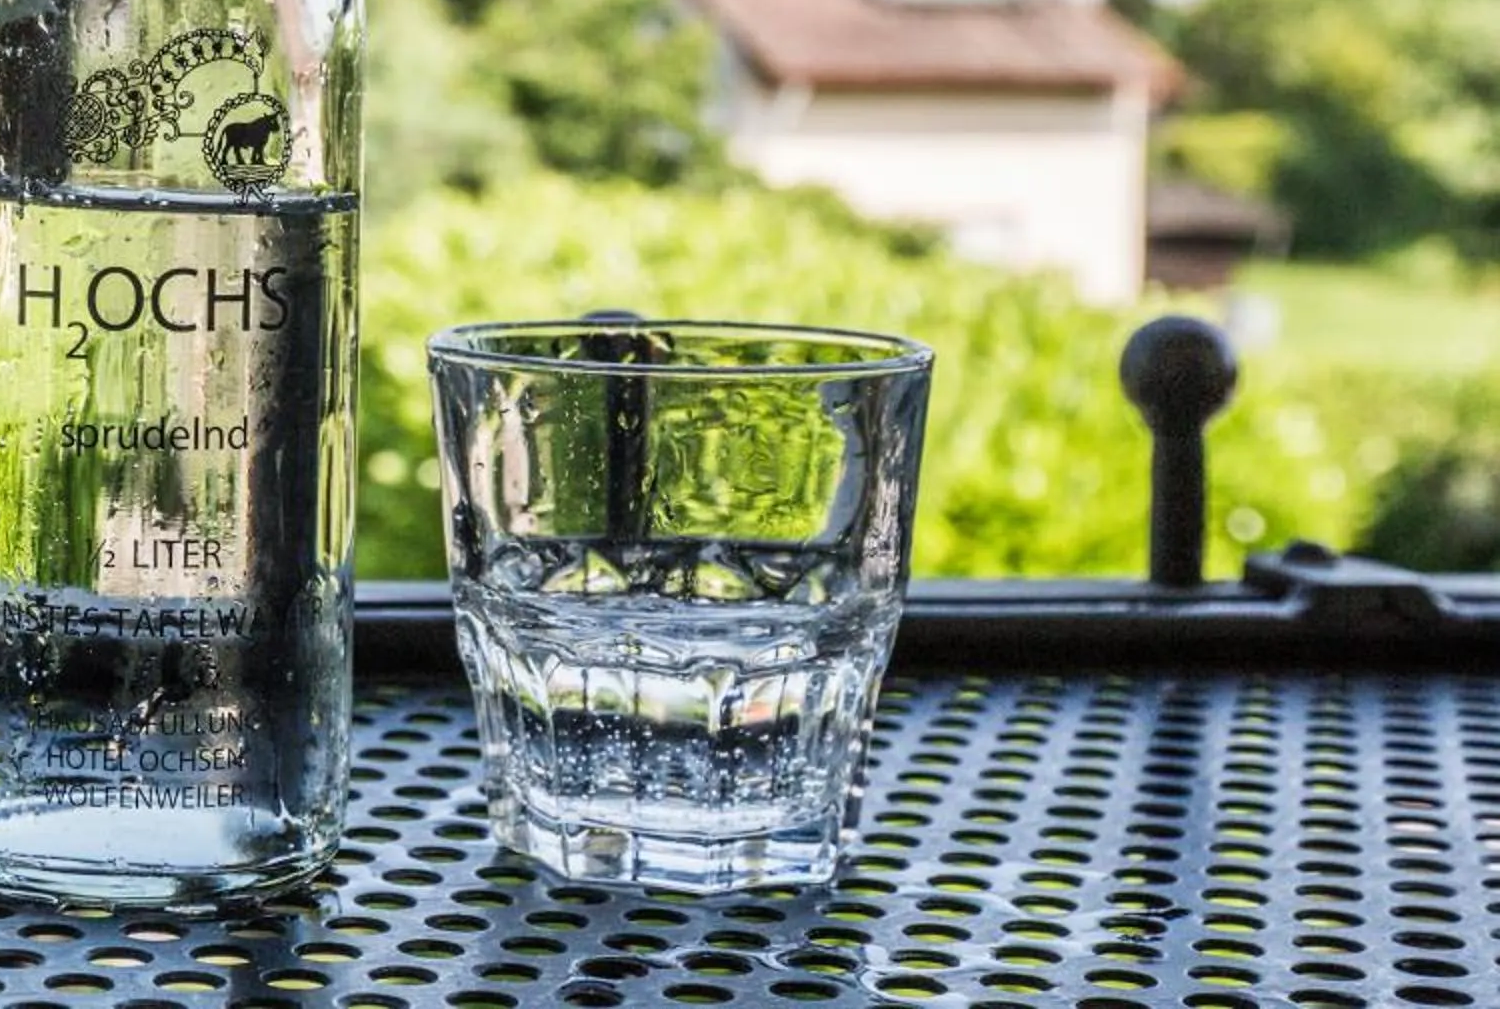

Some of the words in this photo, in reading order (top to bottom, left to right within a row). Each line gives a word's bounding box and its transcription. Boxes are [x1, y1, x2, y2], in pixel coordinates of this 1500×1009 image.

[60, 415, 250, 456] sprudelnd
[132, 538, 223, 569] LITER
[47, 747, 132, 773] HOTEL
[138, 747, 245, 773] OCHSEN
[42, 783, 245, 810] WOLFENWEILER
